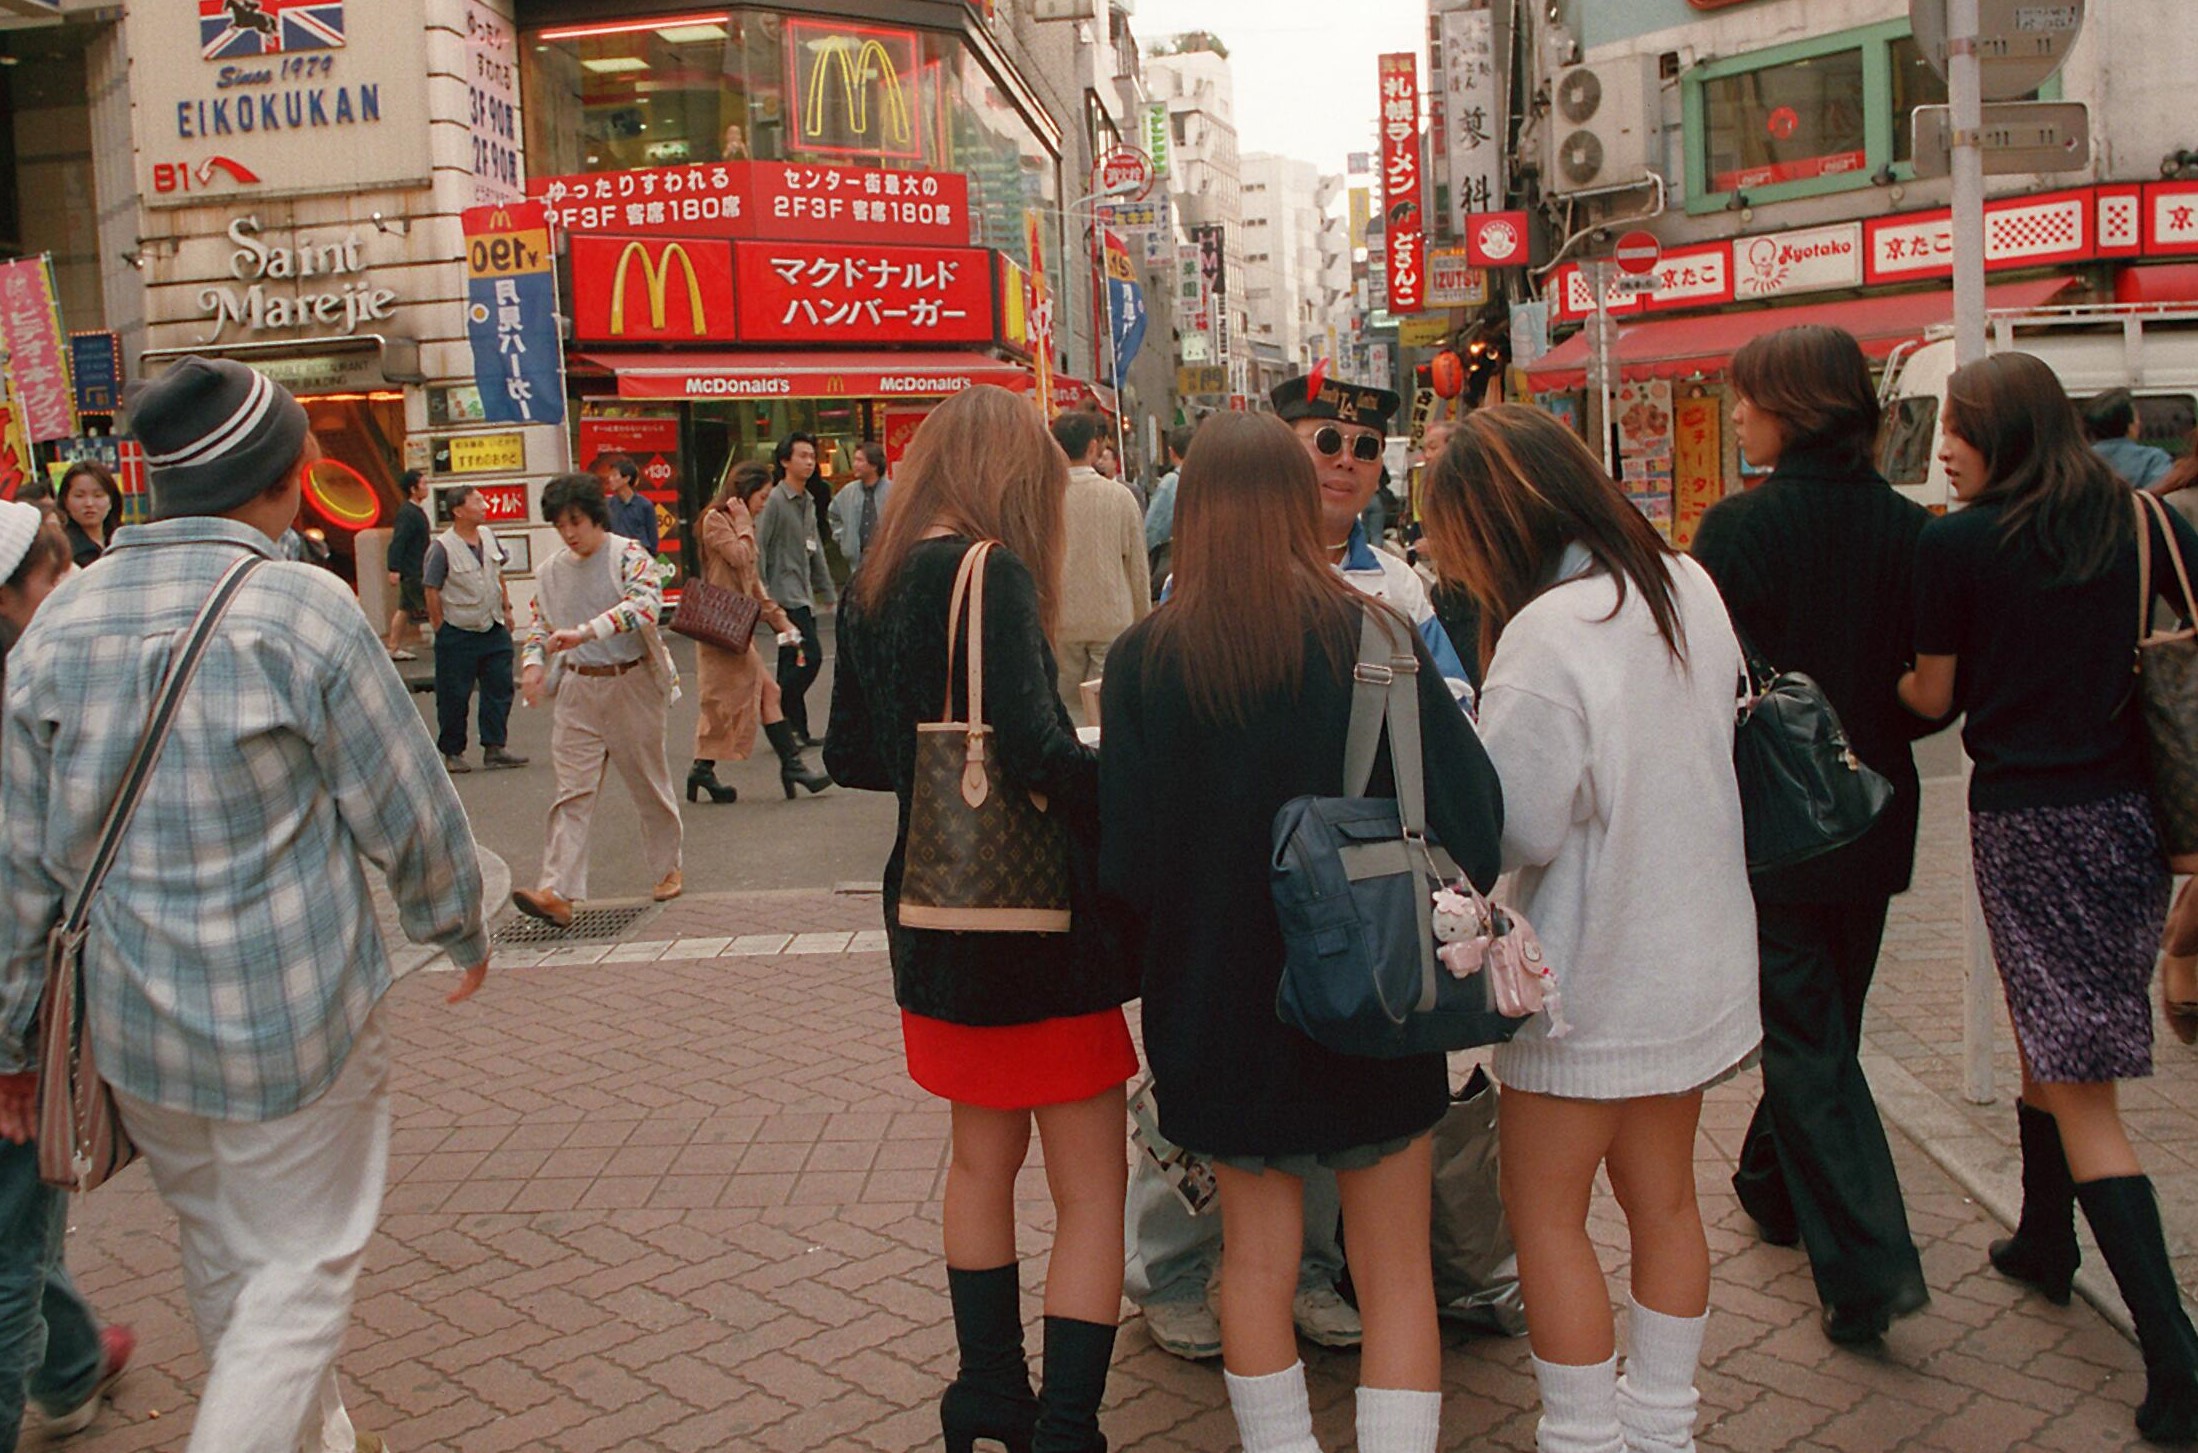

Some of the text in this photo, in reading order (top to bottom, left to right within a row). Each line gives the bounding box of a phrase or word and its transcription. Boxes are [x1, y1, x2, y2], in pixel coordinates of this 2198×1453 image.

[217, 54, 334, 89] Since 1979
[177, 83, 380, 138] EIKOKUKAN
[1383, 77, 1415, 196] 札幌ラーメン
[154, 162, 188, 192] B1
[549, 167, 729, 203] ゆったりすわれる
[784, 167, 938, 197] センター街最大の
[774, 196, 844, 219] 2F3F
[228, 214, 368, 280] Saint
[1198, 231, 1218, 287] HMV
[1778, 240, 1852, 265] Kyotako
[1885, 233, 1952, 260] 京たこ
[770, 256, 960, 290] マクドナルド
[1394, 231, 1417, 306] どさんこ
[1433, 270, 1481, 289] IZUTSU
[1661, 265, 1717, 289] 京たこ
[197, 281, 397, 344] Marejie
[782, 297, 967, 327] ハンバーガー
[686, 376, 790, 395] McDonald's
[879, 375, 972, 392] McDonald's
